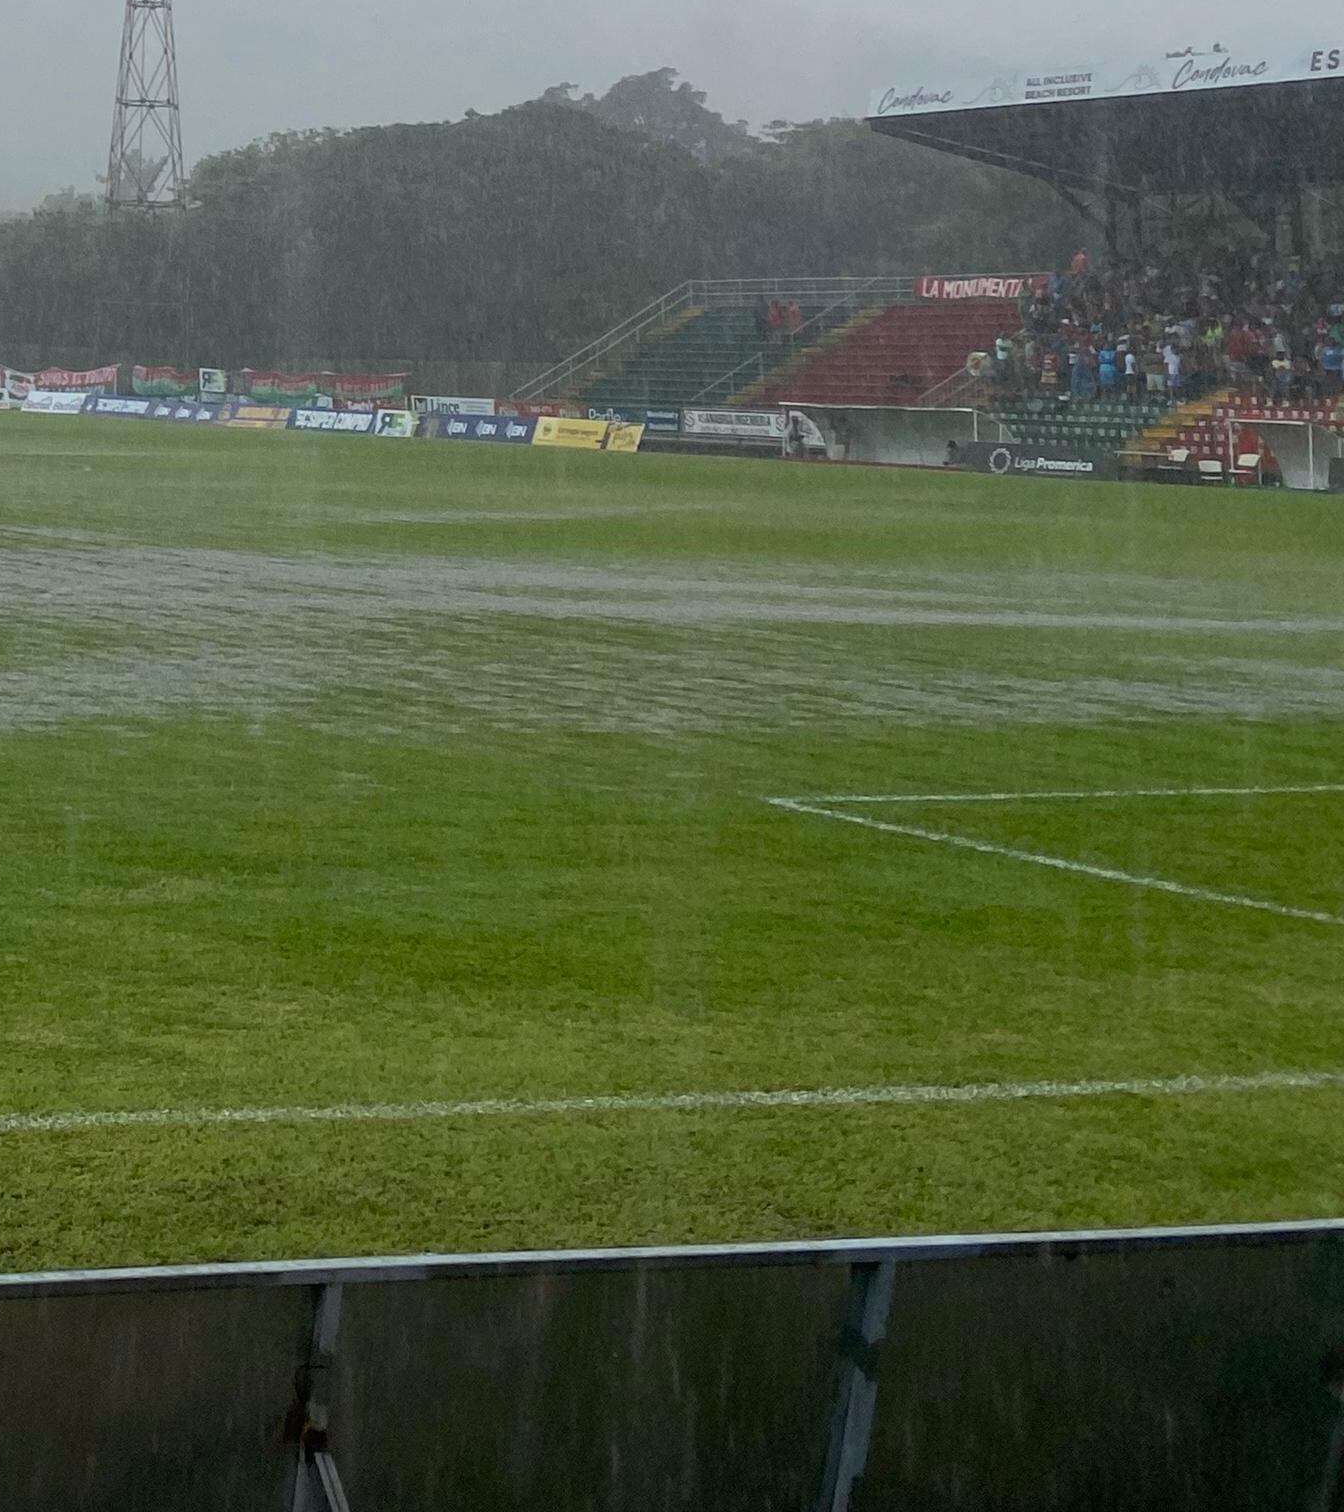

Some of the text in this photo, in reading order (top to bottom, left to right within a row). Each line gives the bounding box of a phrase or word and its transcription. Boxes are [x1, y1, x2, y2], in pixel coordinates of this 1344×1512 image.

[1026, 72, 1093, 87] ALL INCLUSIVE
[1172, 57, 1269, 89] Condovac
[1025, 86, 1092, 100] BEACH RESORT
[922, 277, 1032, 299] LA MONUMENTA
[430, 398, 461, 414] Lince
[1014, 456, 1093, 472] Liga Promerica
